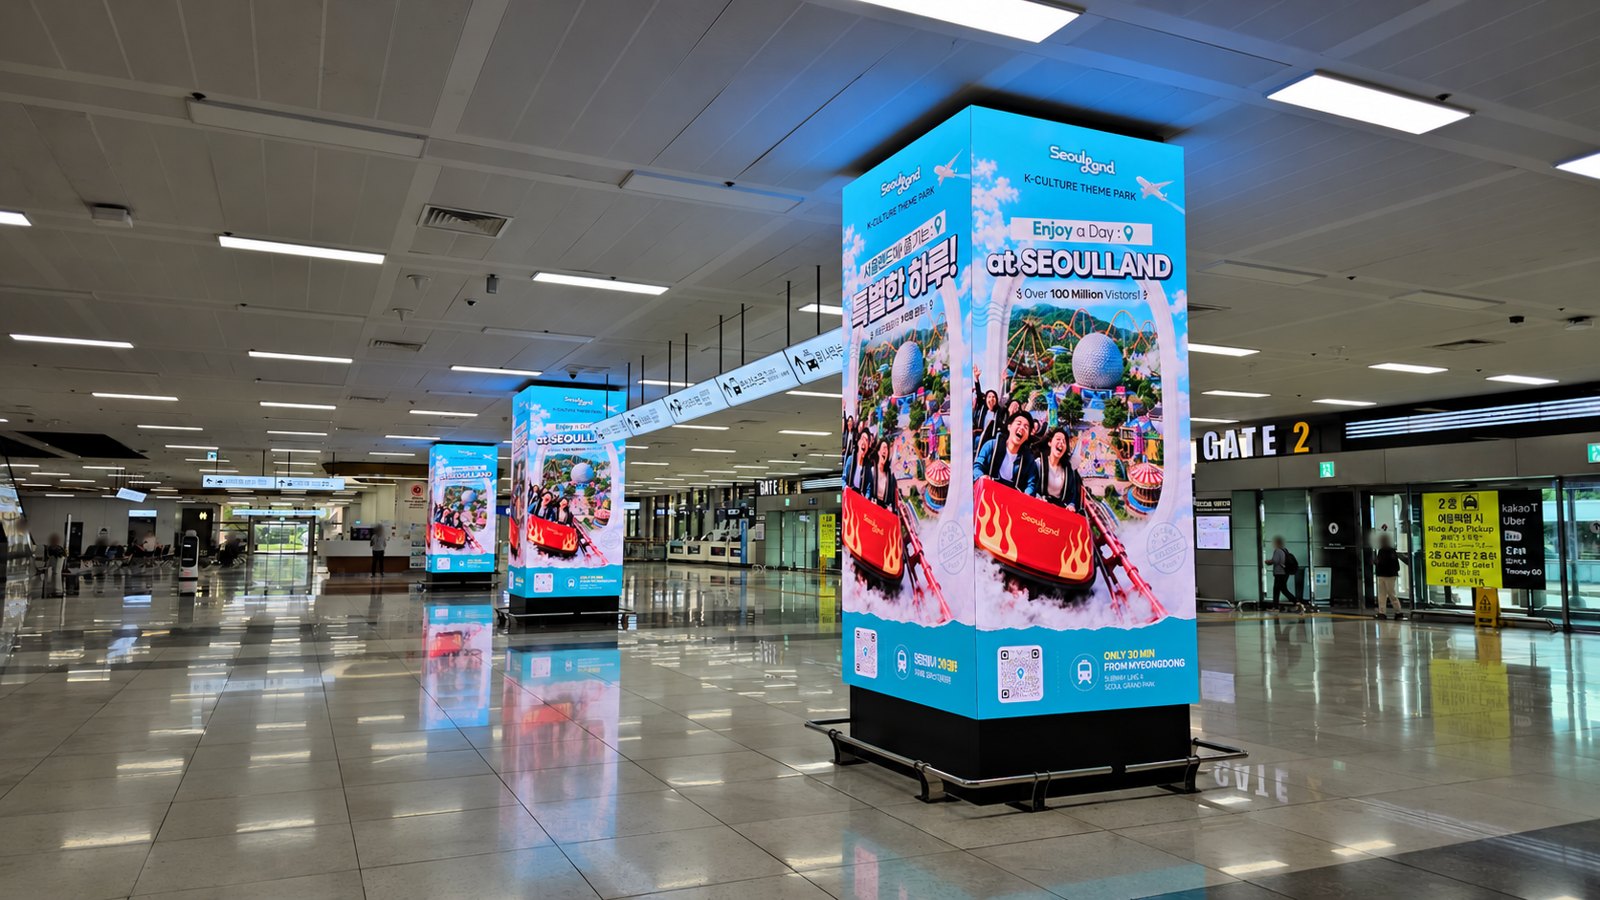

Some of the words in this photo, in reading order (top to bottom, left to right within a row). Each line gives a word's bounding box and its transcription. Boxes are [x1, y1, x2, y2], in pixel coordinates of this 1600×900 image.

[1024, 173, 1078, 191] K-CULTURE
[1080, 183, 1111, 197] THEME
[1113, 189, 1137, 202] PARK
[866, 206, 897, 230] K-CULTURE
[897, 195, 917, 212] THEME
[917, 185, 935, 201] PARK
[1033, 221, 1073, 241] Enjoy
[1076, 226, 1085, 238] a
[1088, 224, 1114, 242] Day
[986, 251, 1018, 277] at
[1020, 248, 1173, 281] SEOULLAND
[851, 265, 907, 329] 특별한
[907, 233, 959, 299] 하루!
[1024, 288, 1048, 299] Over
[1050, 288, 1070, 299] 100
[1071, 288, 1104, 299] Million
[1105, 289, 1141, 300] Vistors!
[1203, 424, 1277, 461] GATE
[1293, 421, 1310, 453] 2
[1502, 504, 1530, 513] kakao
[1531, 503, 1538, 513] T
[1502, 516, 1526, 525] Uber
[1448, 525, 1464, 534] App
[1466, 525, 1494, 535] Pickup
[1444, 551, 1471, 560] GATE
[1505, 568, 1531, 577] Tmoney
[1103, 650, 1126, 660] ONLY
[1127, 649, 1139, 660] 30
[1139, 648, 1156, 658] MIN
[1103, 661, 1128, 672] FROM
[1128, 658, 1186, 671] MYEONGDONG
